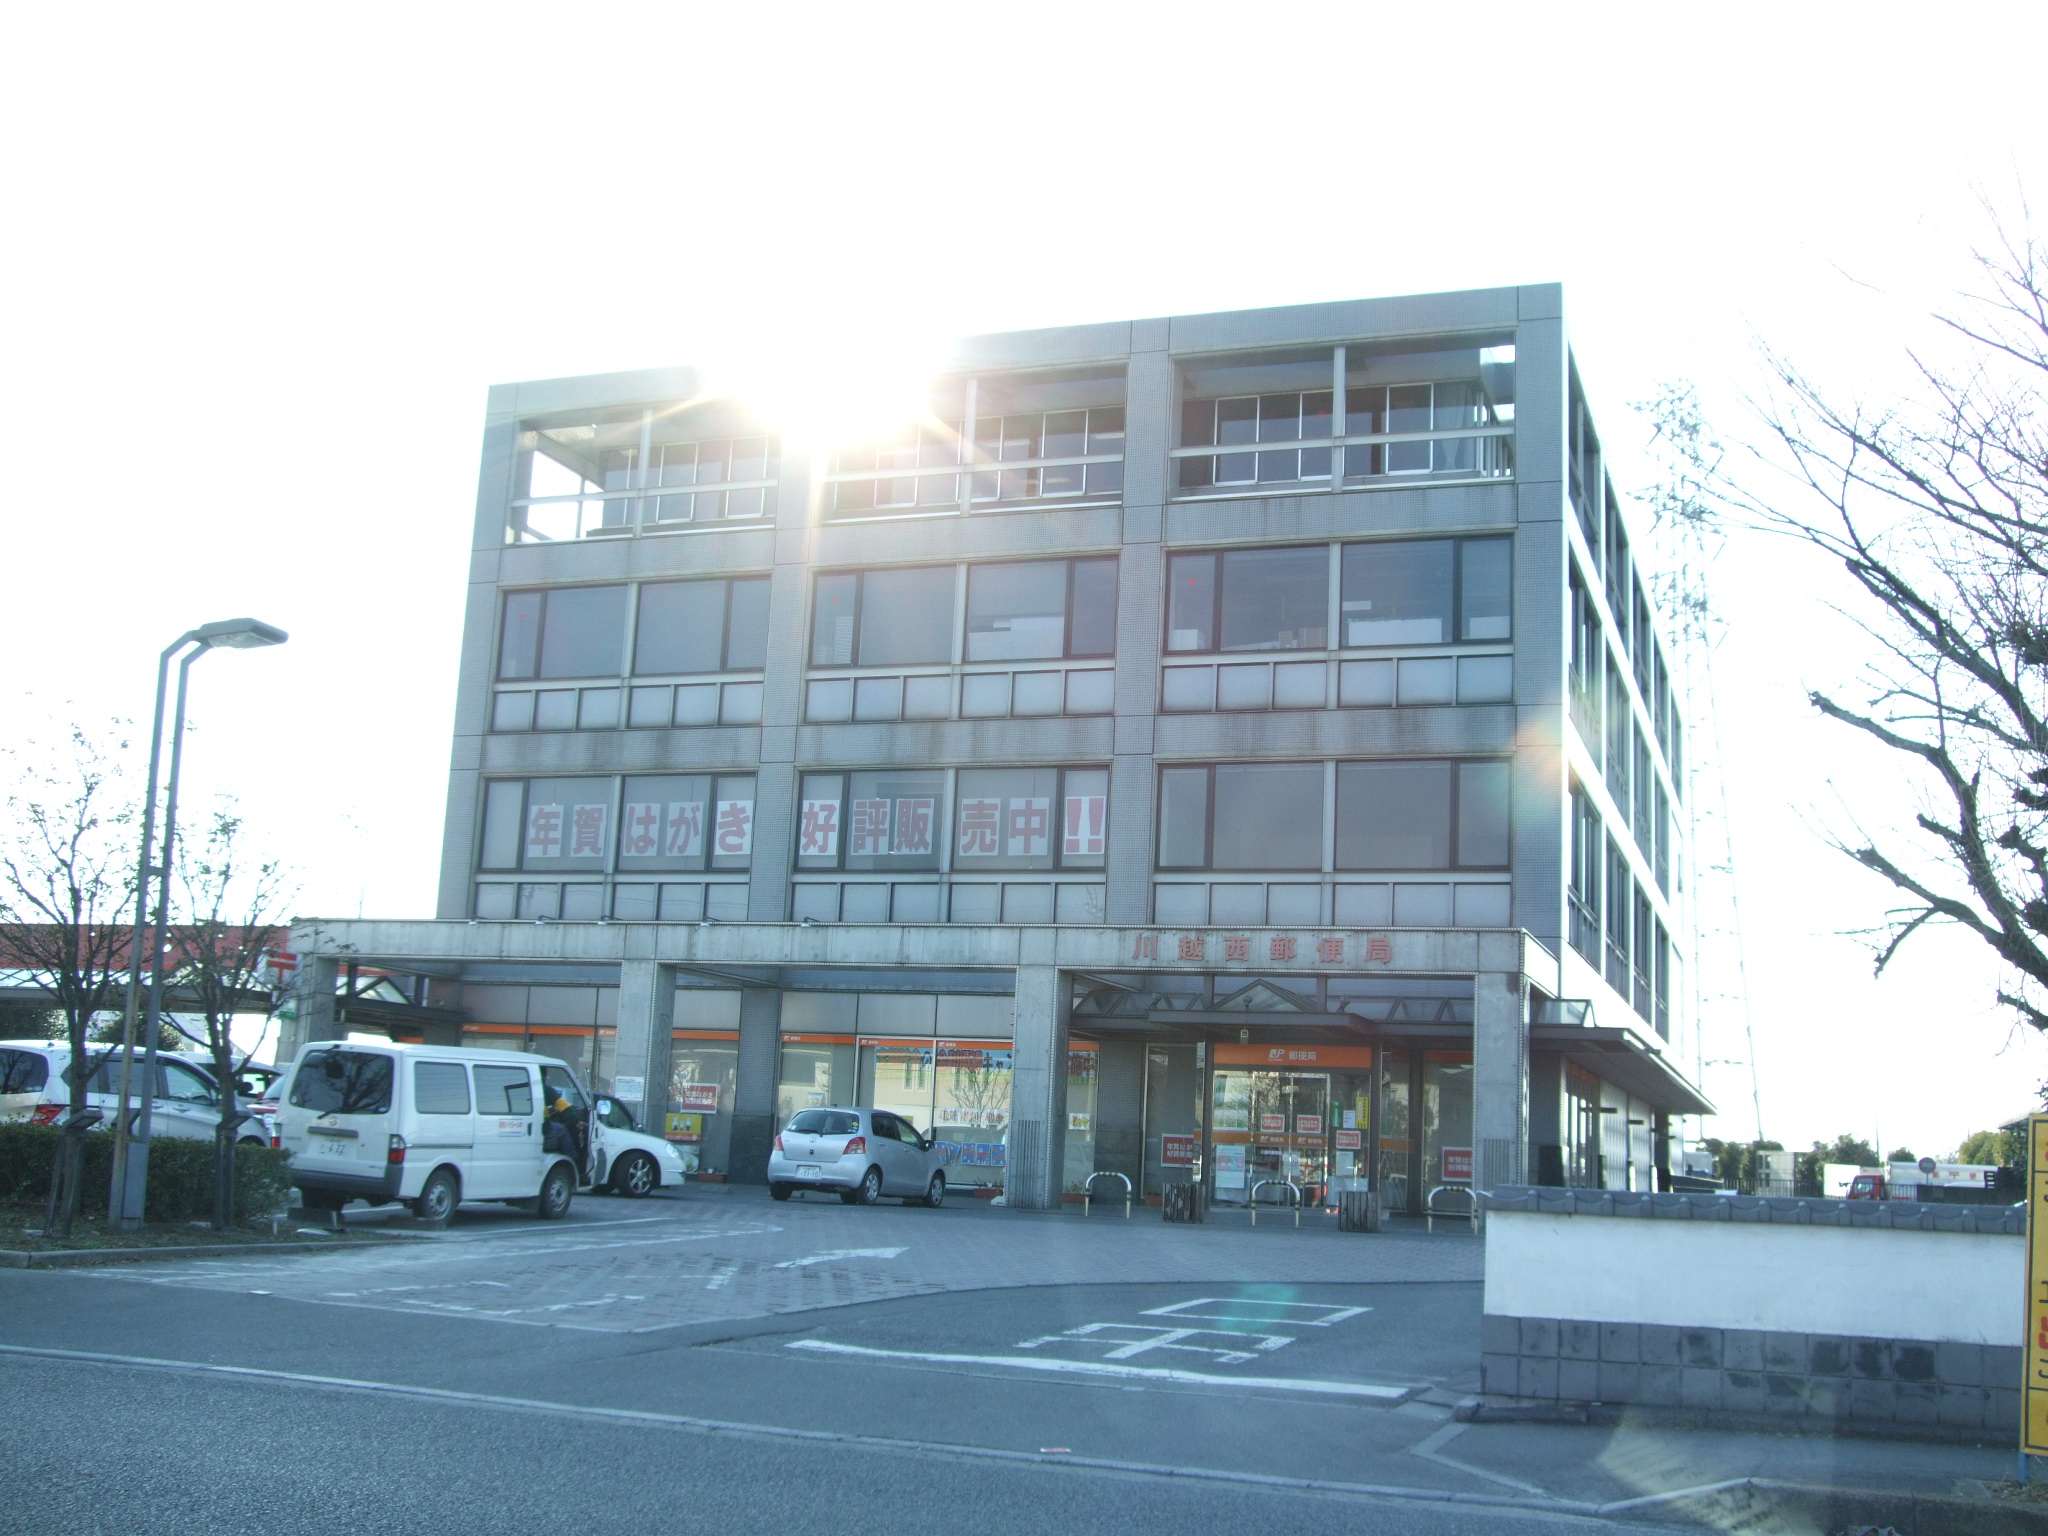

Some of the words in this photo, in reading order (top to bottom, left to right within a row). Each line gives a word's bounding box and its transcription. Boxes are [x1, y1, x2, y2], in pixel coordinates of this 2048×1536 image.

[529, 801, 752, 858] 年賀はがき
[1132, 934, 1393, 965] 川越西郵便局
[1289, 1051, 1317, 1062] 郵便局
[1167, 1143, 1199, 1151] 年賀はが
[1167, 1150, 1199, 1158] 好評販売
